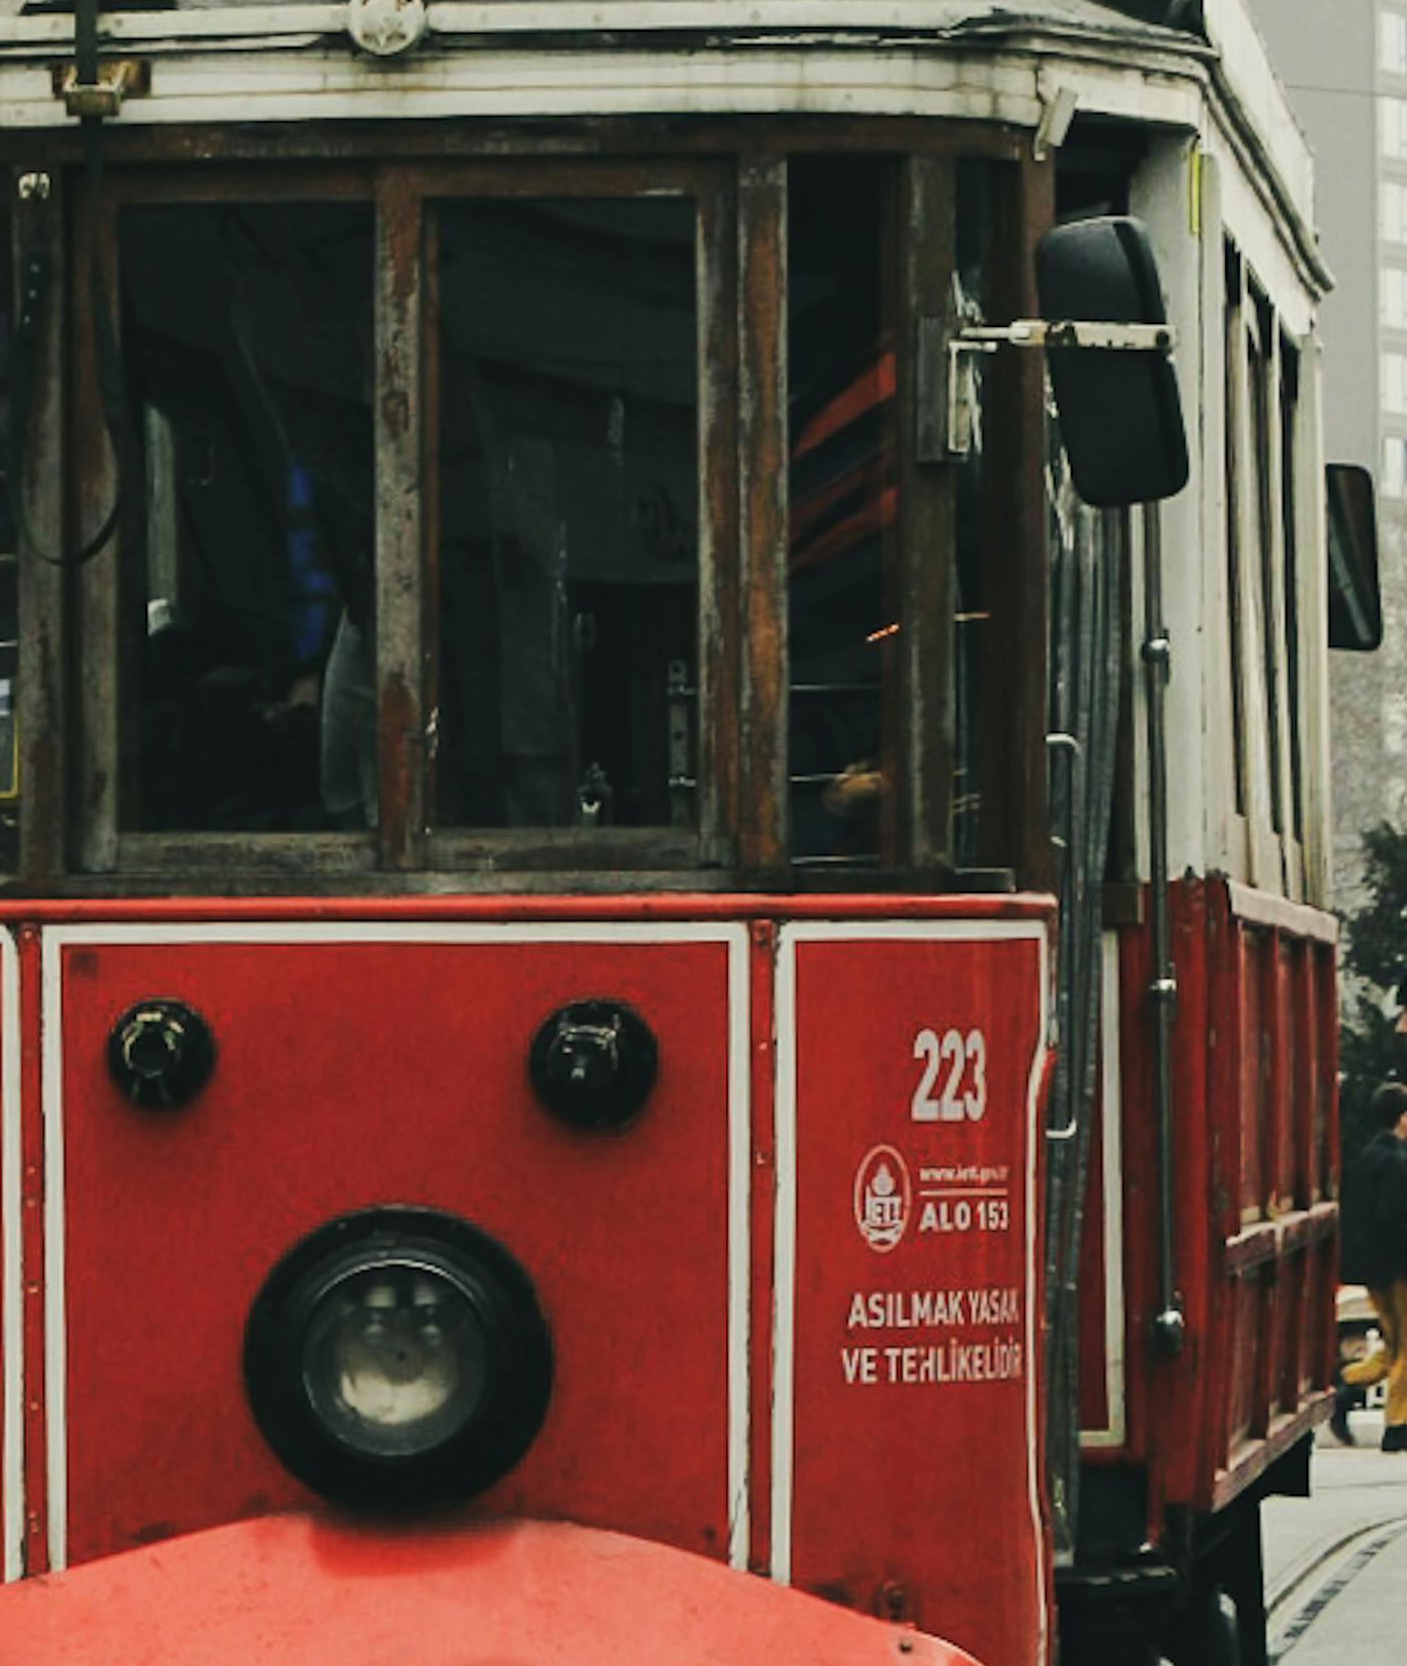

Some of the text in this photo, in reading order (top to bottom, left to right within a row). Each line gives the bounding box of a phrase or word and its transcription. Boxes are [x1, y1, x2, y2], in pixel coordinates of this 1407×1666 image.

[911, 1029, 987, 1121] 223
[918, 1201, 1009, 1232] ALO 153
[848, 1289, 1020, 1329] ASILMAK YASAK
[842, 1335, 1022, 1383] VE TEHLİKELİDİR
